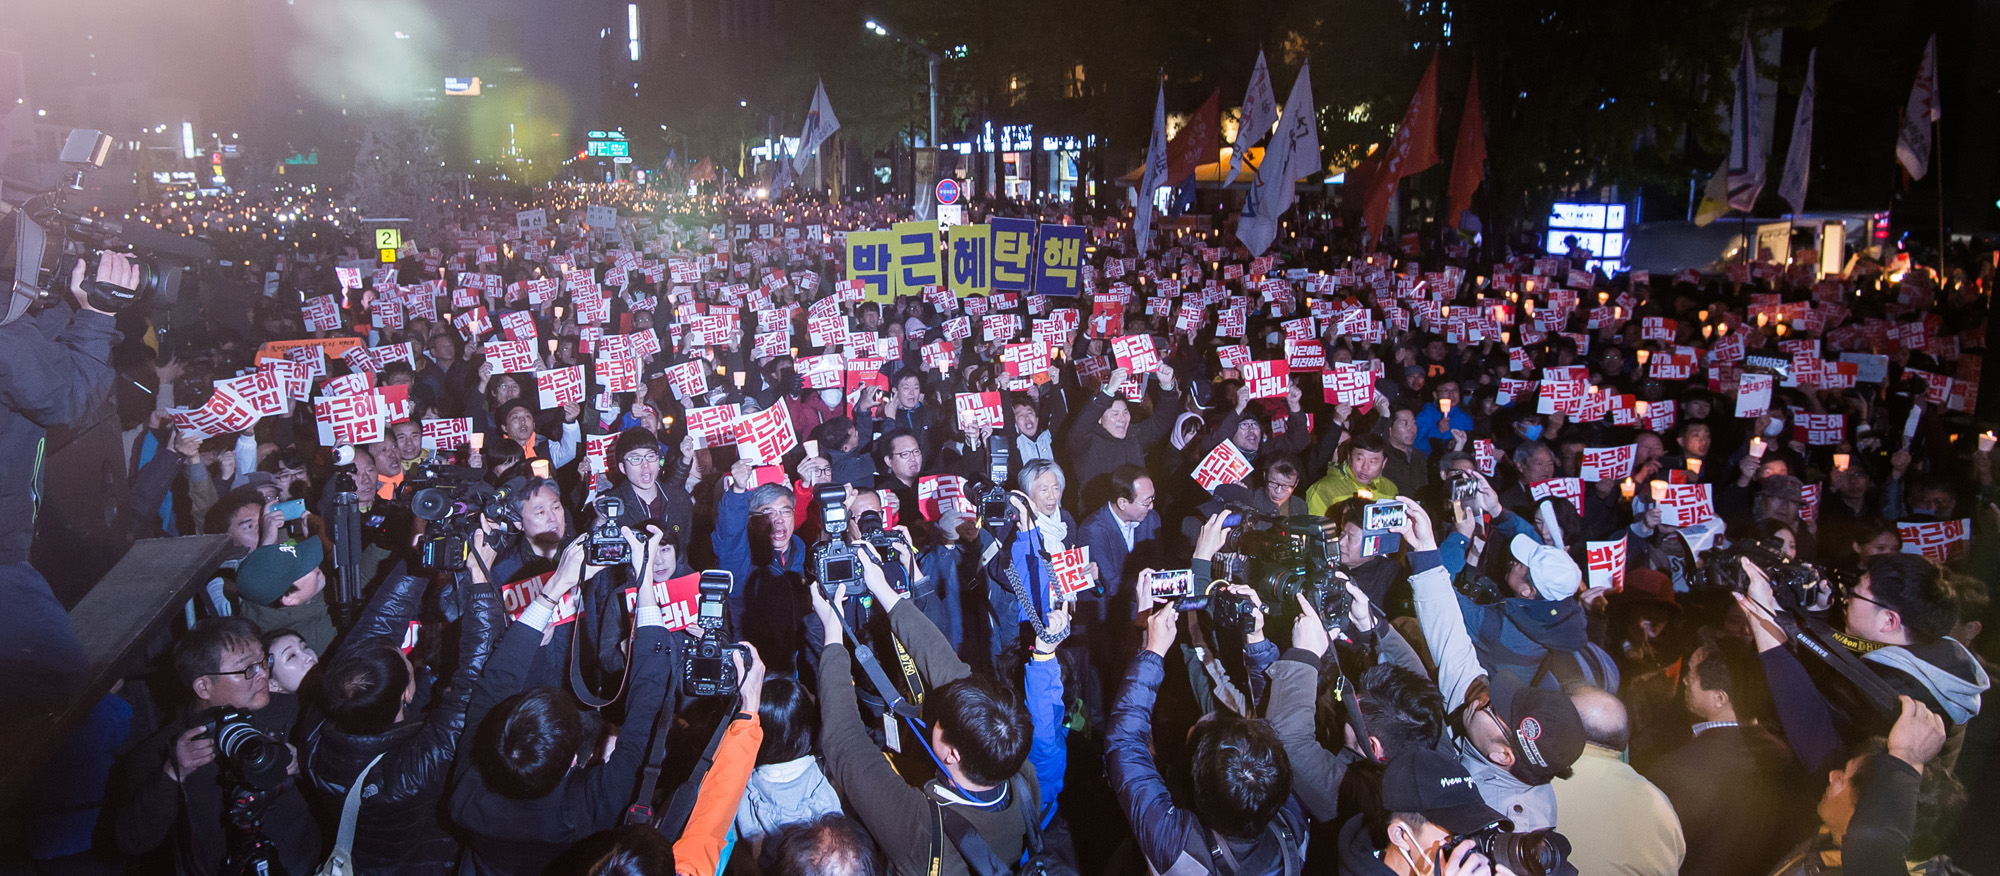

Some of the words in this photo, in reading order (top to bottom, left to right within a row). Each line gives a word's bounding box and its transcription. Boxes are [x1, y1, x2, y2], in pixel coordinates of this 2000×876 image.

[382, 232, 392, 246] 2
[386, 250, 391, 258] 2
[671, 262, 697, 274] 박근혜
[853, 232, 986, 296] 박근혜
[994, 231, 1081, 290] 탄핵
[564, 270, 592, 282] 박근혜
[605, 268, 625, 281] 박근혜
[681, 272, 698, 282] 퇴진
[528, 280, 557, 293] 박근혜
[571, 285, 599, 299] 박근혜
[836, 281, 852, 292] 이게
[1157, 281, 1179, 290] 박근혜
[1261, 281, 1292, 295] 박근혜
[541, 290, 557, 302] 퇴진
[931, 290, 955, 305] 박근혜
[963, 298, 988, 309] 박근혜
[302, 306, 336, 323] 박근혜
[371, 301, 402, 317] 박근혜
[408, 302, 432, 315] 박근혜
[578, 300, 605, 314] 박근혜
[808, 297, 836, 318] 박근혜
[1450, 307, 1478, 317] 박근혜
[316, 319, 338, 330] 퇴진
[382, 314, 402, 328] 퇴진
[502, 311, 531, 328] 박근혜
[587, 312, 607, 323] 퇴진
[691, 315, 730, 333] 박근혜
[759, 311, 788, 323] 박근혜
[808, 316, 845, 334] 박근혜
[983, 316, 1013, 329] 박근혜
[1469, 319, 1499, 331] 박근혜
[1534, 310, 1567, 324] 박근혜
[1642, 318, 1663, 329] 이게
[769, 321, 788, 332] 퇴진
[943, 318, 968, 334] 박근혜
[951, 328, 969, 340] 퇴진
[993, 326, 1013, 339] 퇴진
[1033, 320, 1064, 334] 박근혜
[1226, 327, 1244, 338] 퇴진
[1344, 320, 1367, 333] 퇴진
[1642, 326, 1677, 341] 나라냐
[599, 336, 629, 353] 박근혜
[704, 331, 731, 346] 퇴진
[755, 333, 786, 346] 박근혜
[822, 331, 847, 346] 퇴진
[844, 333, 875, 348] 박근혜
[1043, 332, 1065, 346] 퇴진
[371, 342, 408, 364] 박근혜
[485, 339, 532, 358] 박근혜
[637, 341, 659, 357] 퇴진
[764, 344, 787, 357] 퇴진
[921, 344, 940, 356] 이게
[1005, 341, 1047, 362] 박근혜
[1113, 336, 1155, 358] 박근혜
[1220, 346, 1248, 361] 박근혜
[1290, 345, 1322, 357] 박근혜는
[1716, 347, 1742, 360] 퇴진
[502, 356, 533, 373] 퇴진
[848, 360, 864, 371] 이게
[1020, 357, 1048, 376] 퇴진
[1131, 354, 1158, 373] 퇴진
[1652, 354, 1672, 365] 이게
[260, 361, 308, 381] 박근혜
[596, 361, 636, 379] 박근혜
[667, 360, 702, 384] 박근혜
[1243, 361, 1272, 382] 이게
[1545, 368, 1569, 380] 이게
[1649, 363, 1690, 379] 나라냐
[321, 373, 370, 397] 박근혜
[538, 366, 582, 391] 박근혜
[610, 375, 637, 394] 퇴진
[810, 369, 841, 389] 퇴진
[1322, 370, 1371, 391] 박근혜
[680, 379, 706, 398] 퇴진
[1248, 376, 1289, 399] 나라냐
[1541, 382, 1583, 399] 박근혜
[555, 386, 583, 407] 퇴진
[957, 396, 984, 411] 이게
[1337, 387, 1370, 406] 퇴진
[169, 388, 235, 431] 박근혜
[316, 395, 378, 423] 박근혜
[1554, 399, 1581, 414] 퇴진
[202, 410, 254, 437] 퇴진
[687, 405, 735, 430] 박근혜
[734, 400, 786, 444] 박근혜
[1794, 413, 1843, 429] 박근혜
[333, 419, 378, 443] 퇴진
[422, 417, 468, 437] 박근혜
[436, 434, 466, 452] 퇴진
[705, 425, 736, 448] 퇴진
[758, 424, 794, 464] 퇴진
[1808, 429, 1843, 445] 퇴진
[1196, 442, 1235, 489] 박근혜
[1583, 446, 1630, 470] 박근혜
[1219, 458, 1249, 485] 퇴진
[1599, 465, 1628, 481] 퇴진
[1531, 479, 1581, 500] 박근혜
[1660, 485, 1707, 508] 박근혜
[1678, 503, 1714, 527] 퇴진
[1897, 520, 1965, 546] 박근혜
[503, 577, 543, 612] 이게
[1797, 633, 1829, 658] SAMSUNG
[1832, 632, 1857, 649] Nikon
[901, 654, 915, 676] D750
[1440, 776, 1462, 788] New
